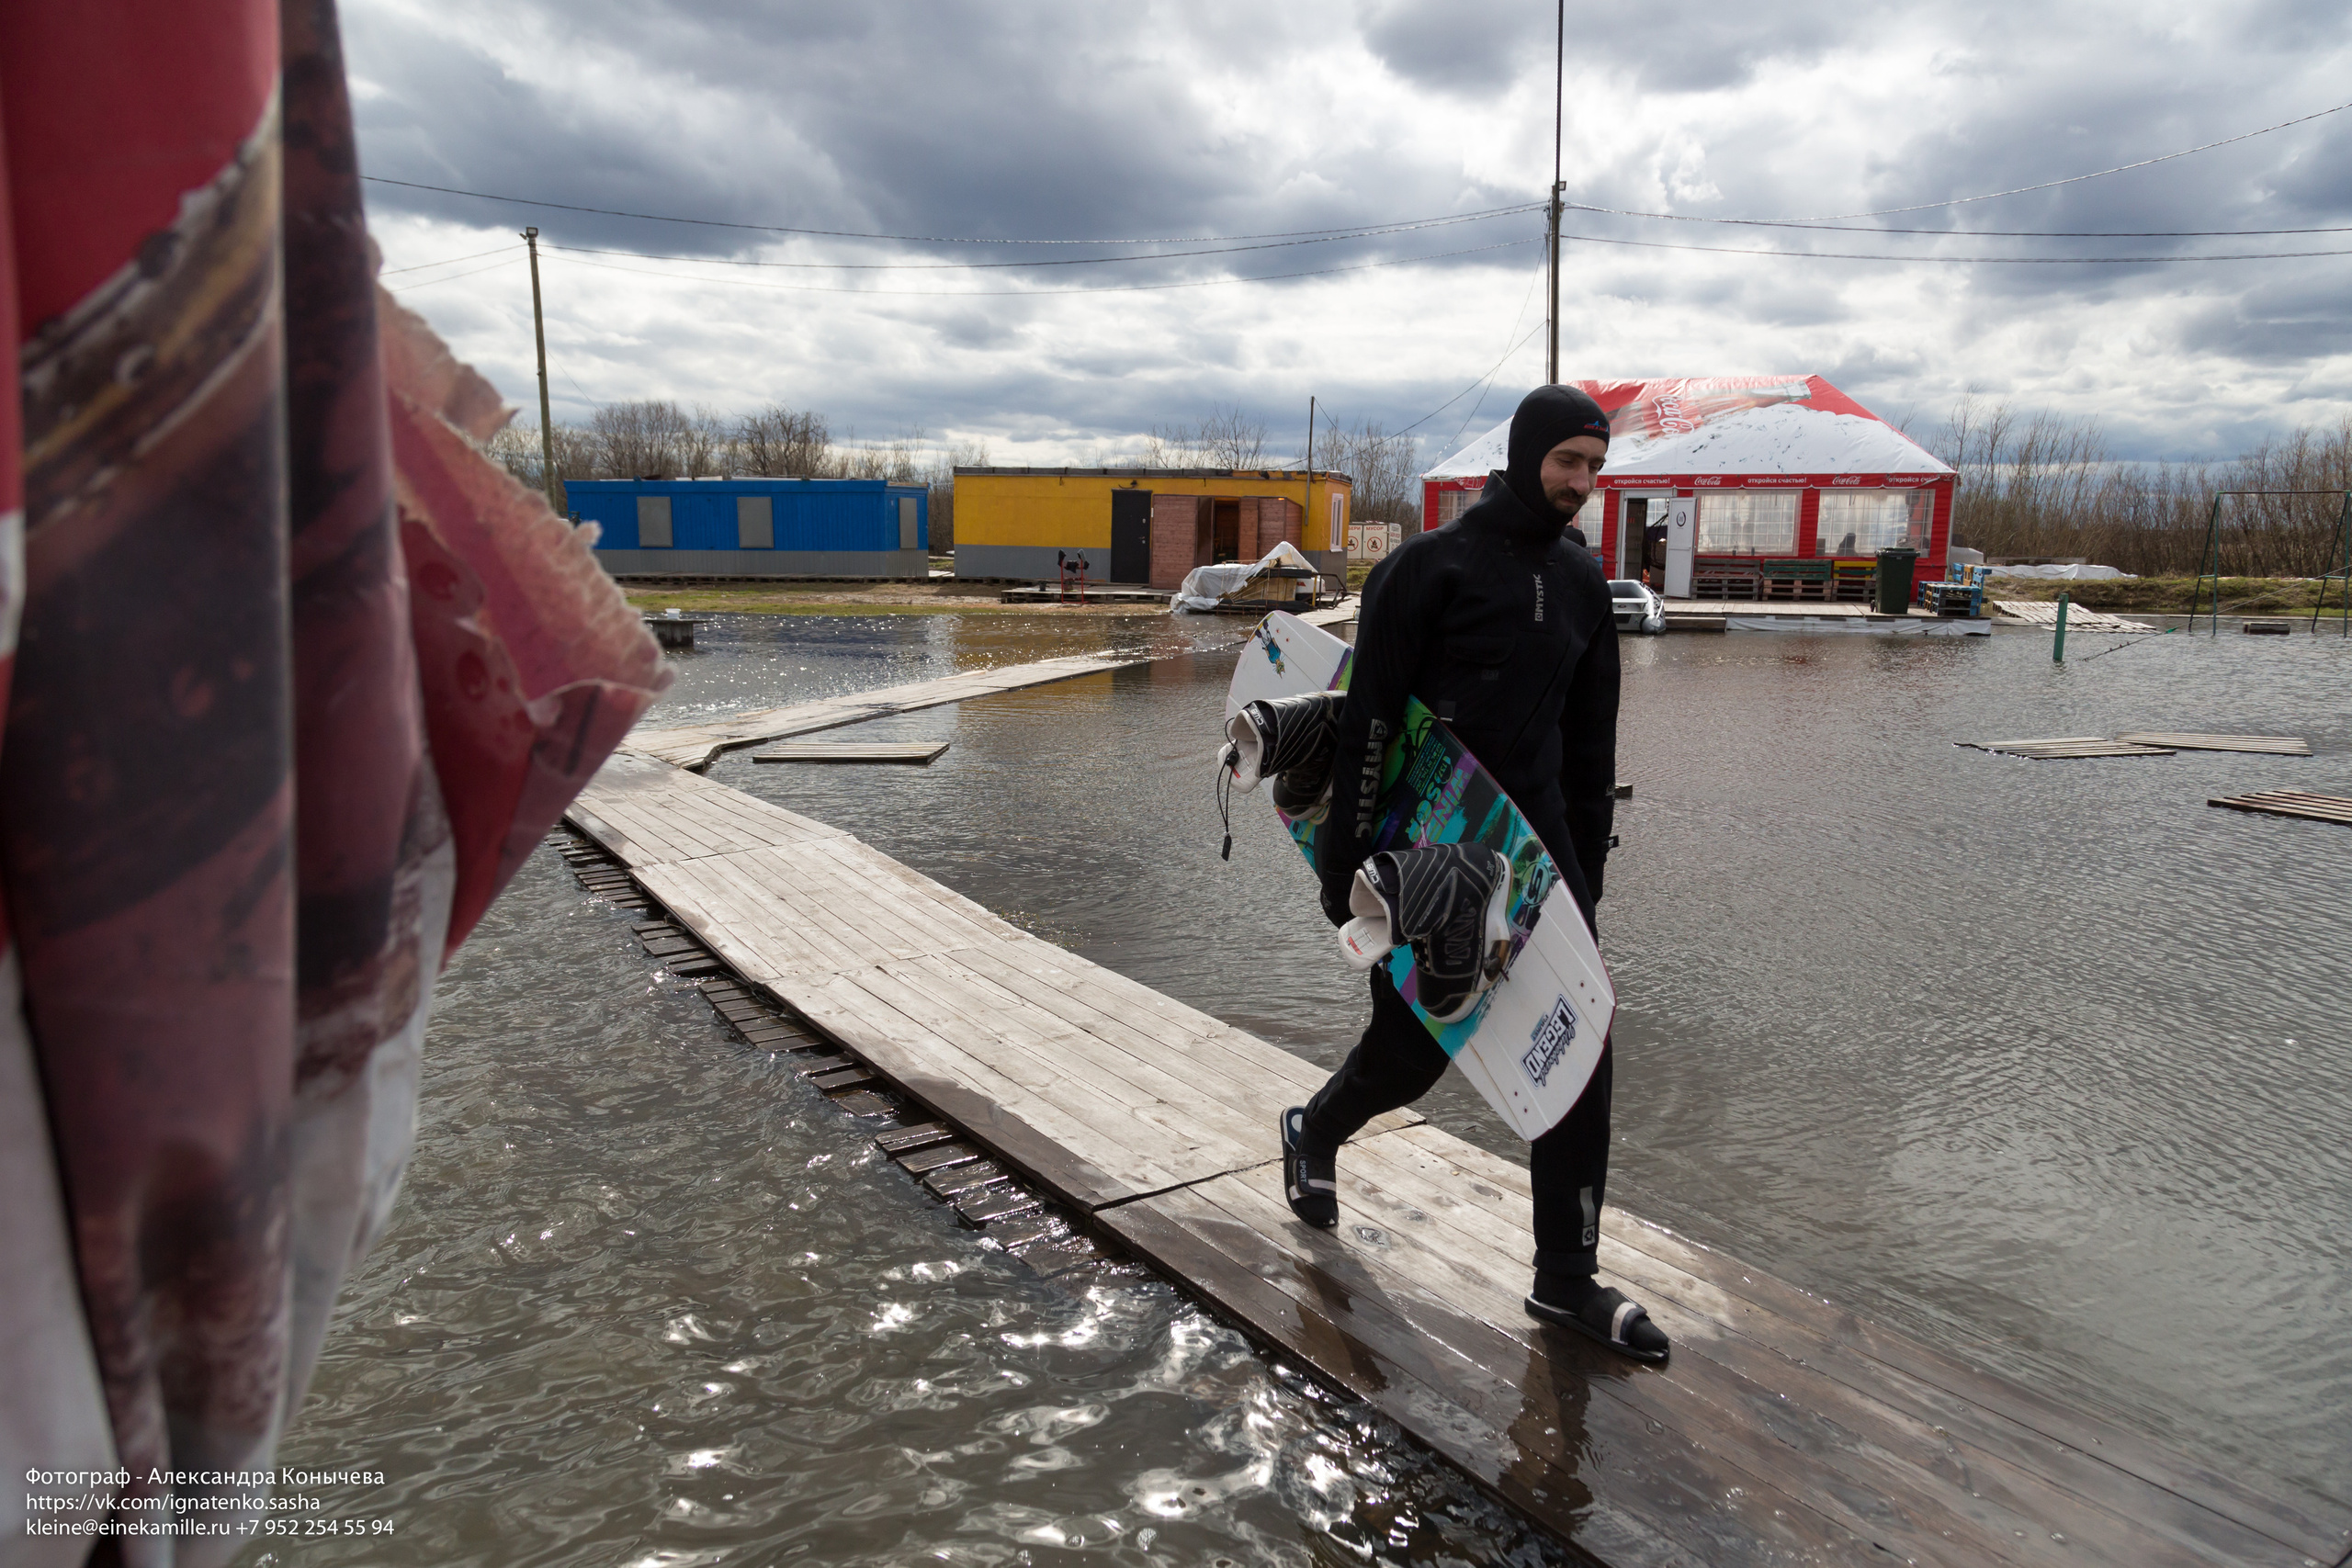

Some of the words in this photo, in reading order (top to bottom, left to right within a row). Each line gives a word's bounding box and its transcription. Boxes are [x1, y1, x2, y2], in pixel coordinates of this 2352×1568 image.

[1613, 477, 1643, 485] откройся
[1533, 573, 1544, 613] MYSTIC
[1355, 740, 1384, 839] MYSTIC
[1524, 1000, 1575, 1078] LEGEND
[1299, 1160, 1307, 1183] SPORT
